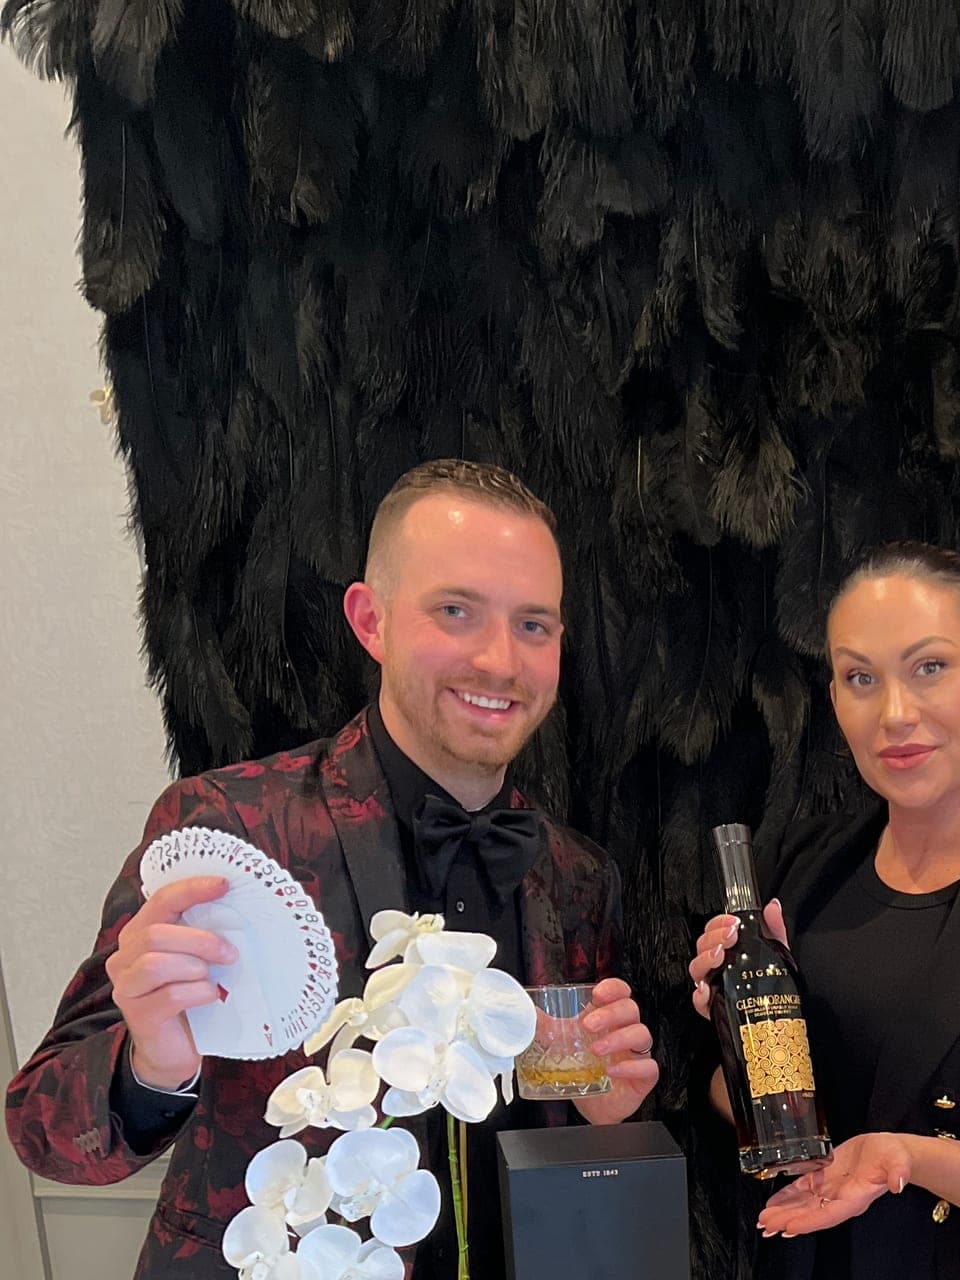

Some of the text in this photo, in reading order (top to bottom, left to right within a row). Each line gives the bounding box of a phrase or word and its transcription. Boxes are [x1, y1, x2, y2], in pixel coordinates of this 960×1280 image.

[262, 864, 275, 875] 5
[284, 885, 297, 896] 8
[318, 955, 332, 966] 8
